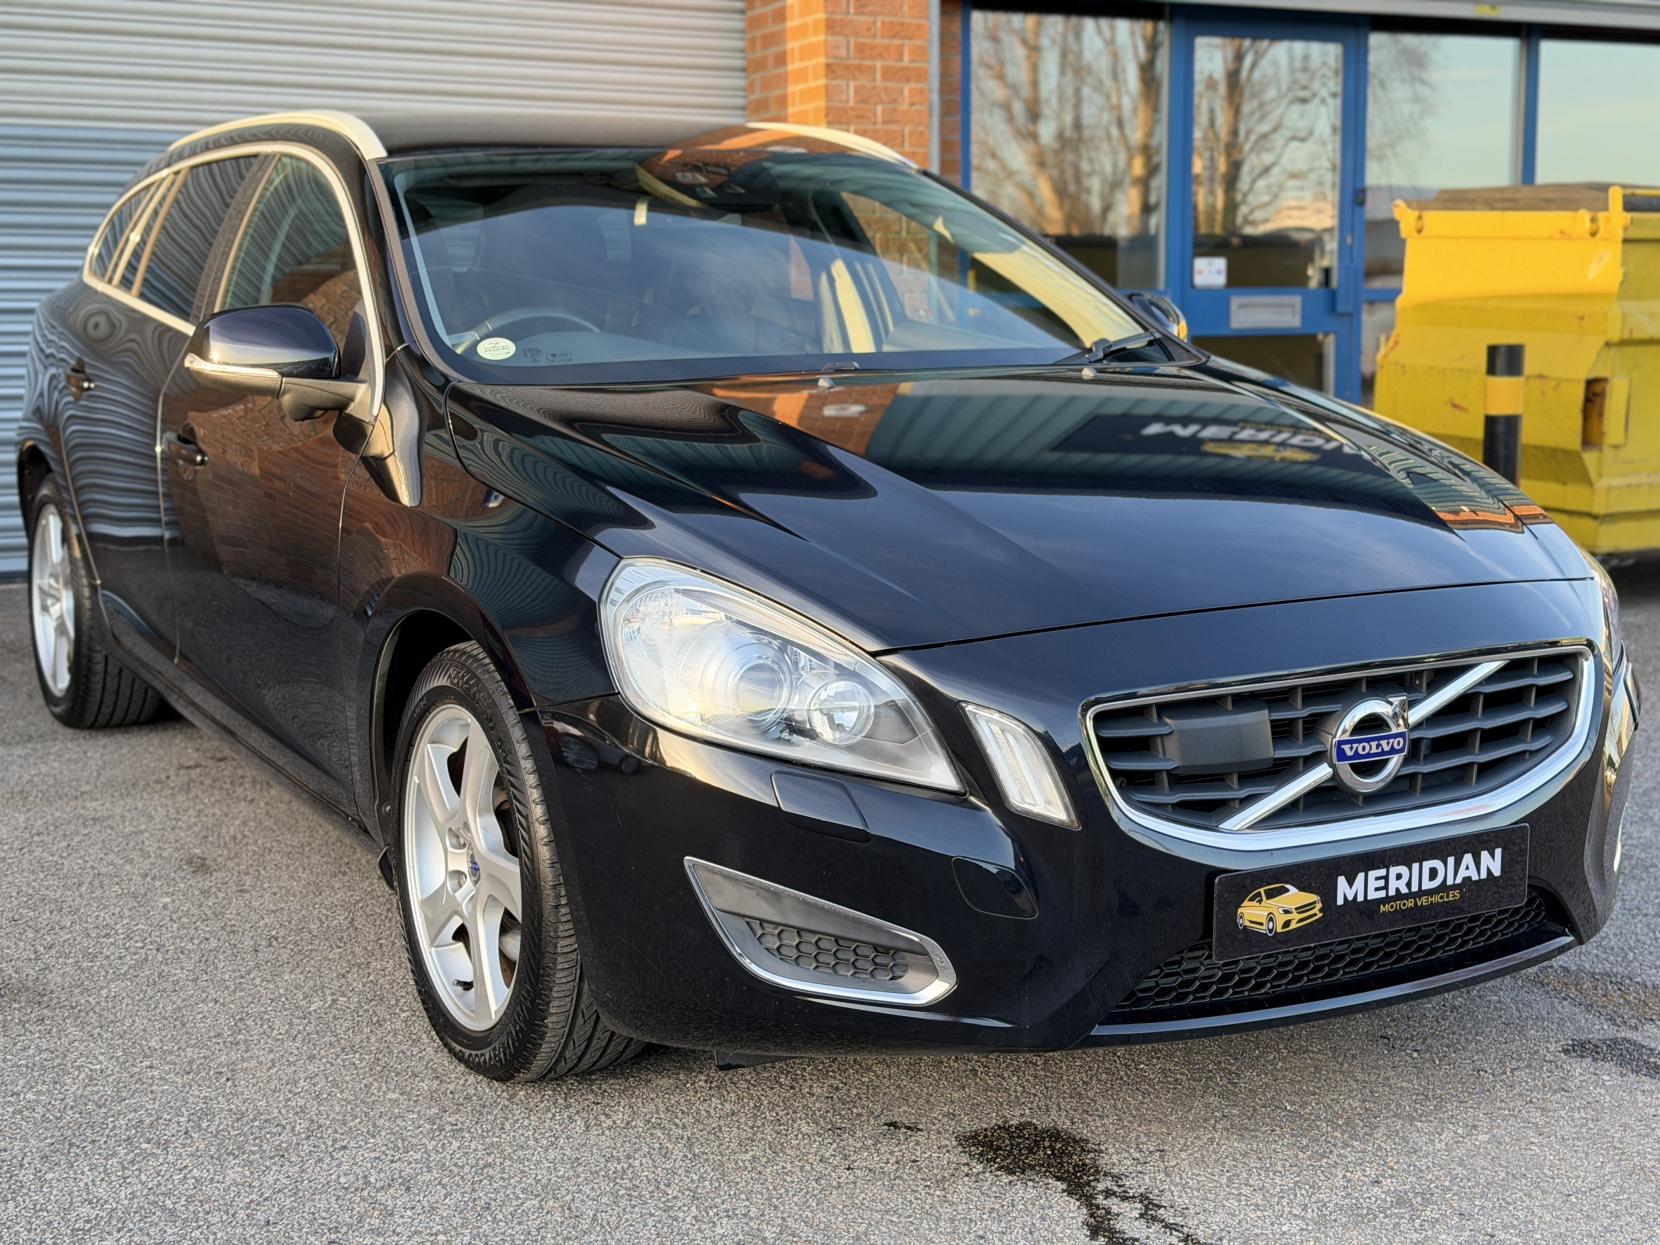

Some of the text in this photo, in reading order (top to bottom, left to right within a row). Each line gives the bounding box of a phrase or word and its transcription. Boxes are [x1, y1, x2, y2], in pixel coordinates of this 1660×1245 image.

[1342, 737, 1404, 756] VOLVO
[1336, 847, 1503, 906] MERIDIAN
[1379, 889, 1461, 914] MOTOR VEHICLES
